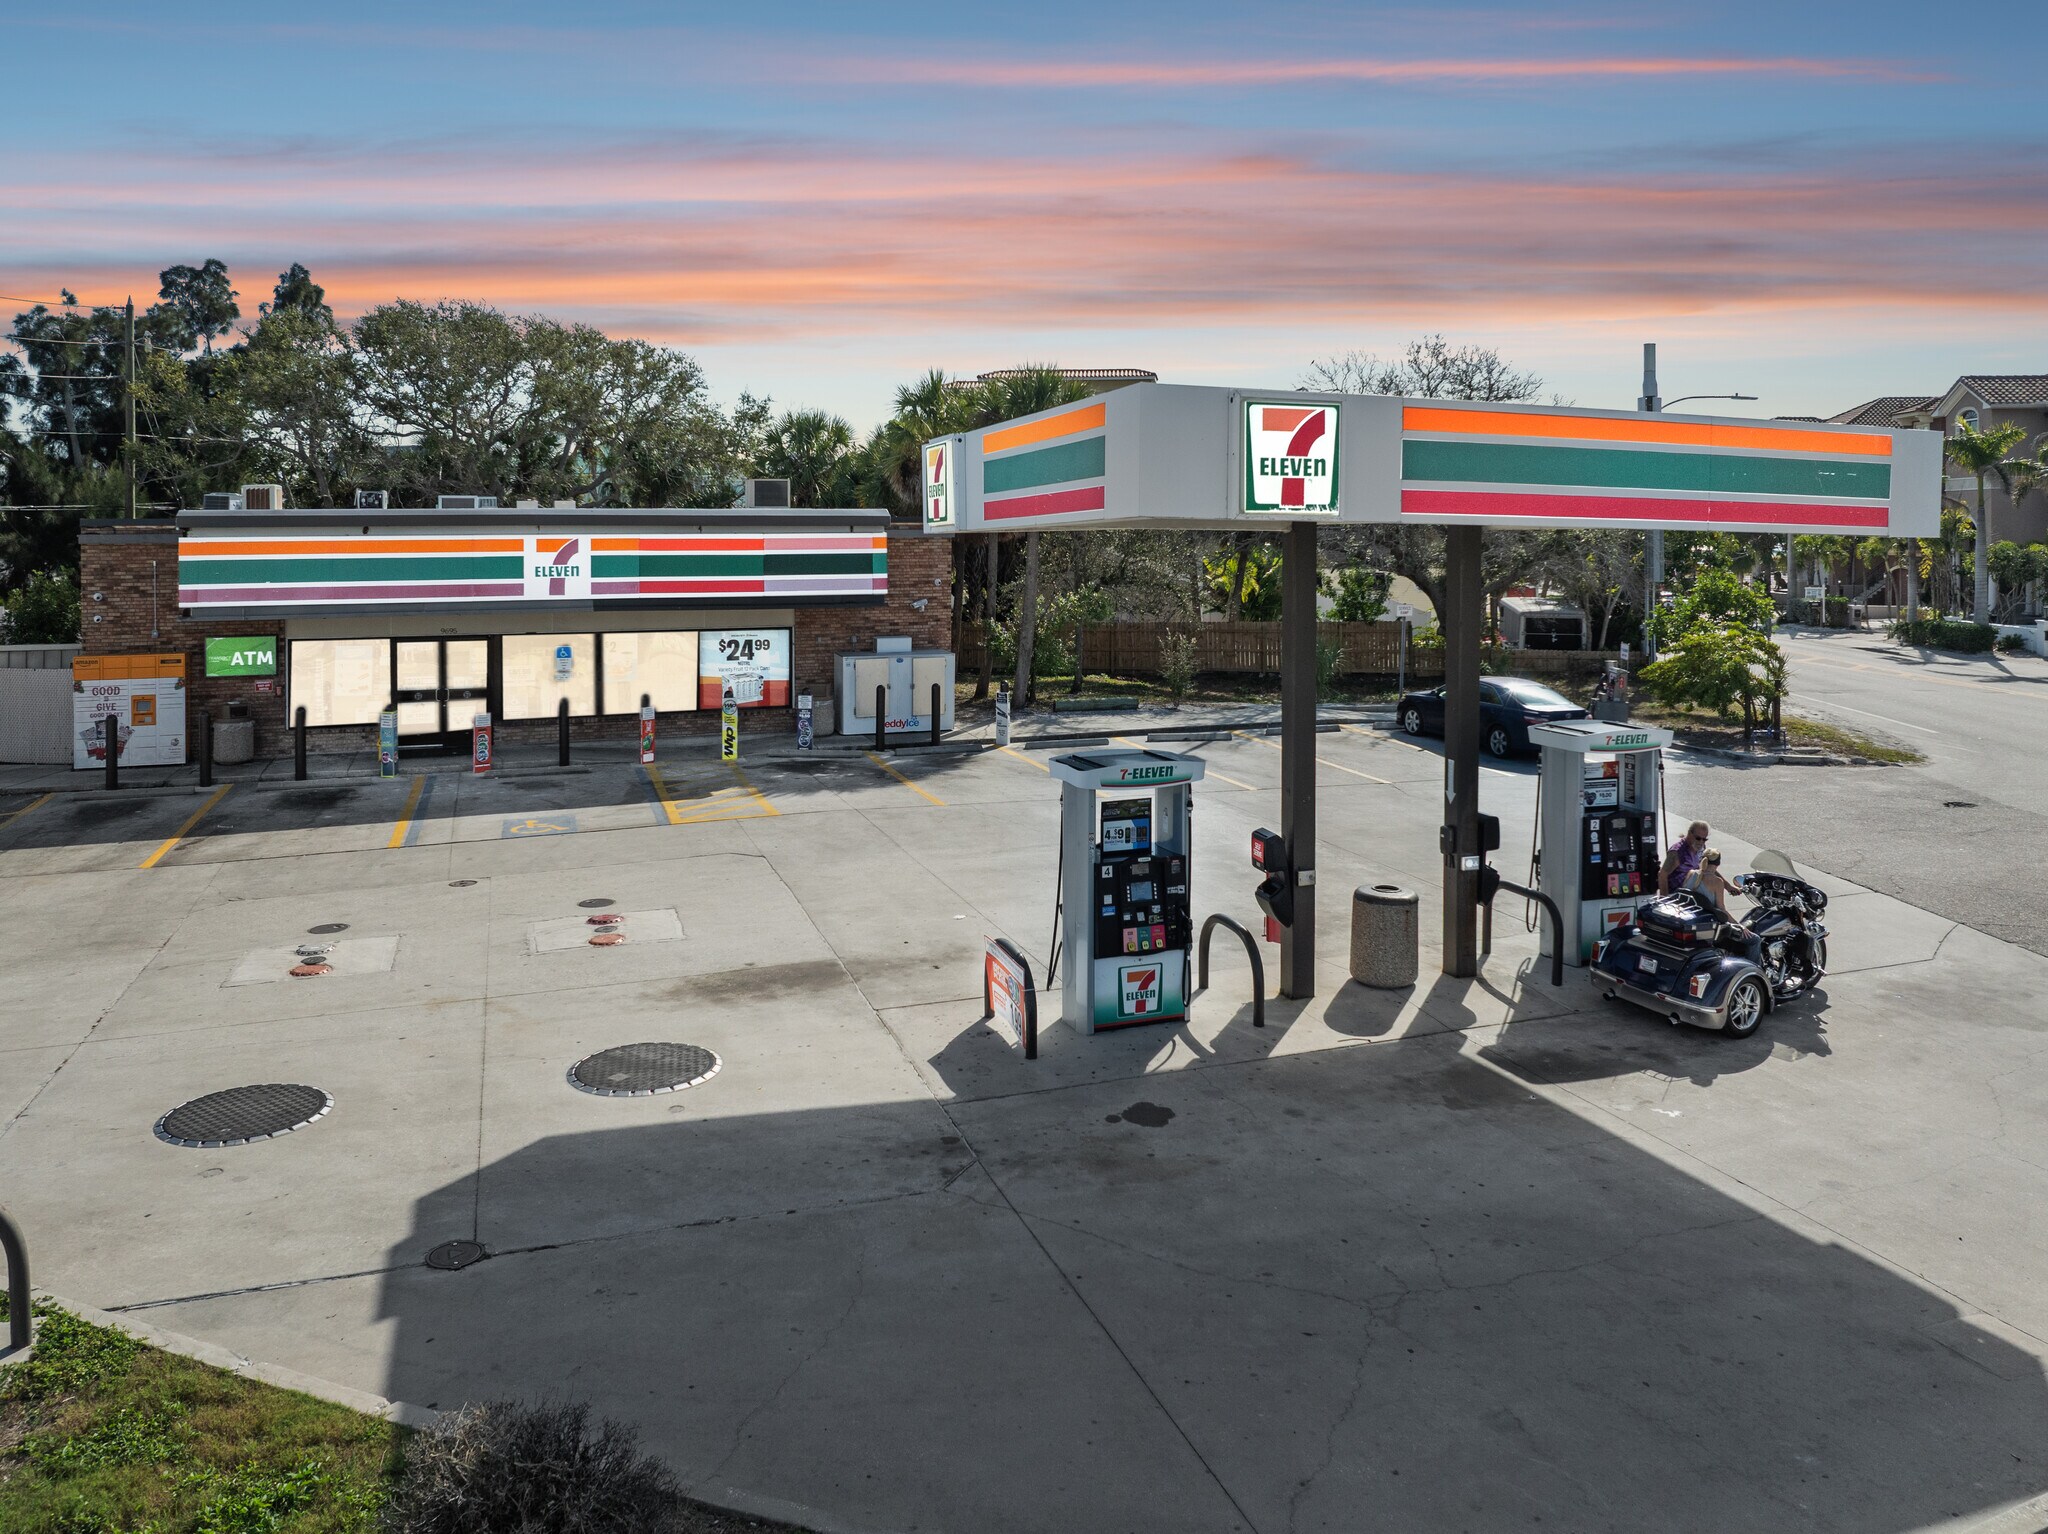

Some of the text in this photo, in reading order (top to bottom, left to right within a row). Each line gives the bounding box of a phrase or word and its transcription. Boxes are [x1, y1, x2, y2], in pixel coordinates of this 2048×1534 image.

[1262, 408, 1325, 507] 7
[929, 447, 944, 519] 7
[536, 538, 579, 596] 7
[231, 651, 273, 666] ATM
[92, 686, 120, 696] GOOD
[96, 703, 116, 711] GIVE
[884, 718, 919, 729] eddyIce
[1593, 821, 1598, 829] 2
[1105, 830, 1111, 840] 4
[1104, 867, 1110, 877] 4
[1127, 968, 1155, 1013] 7
